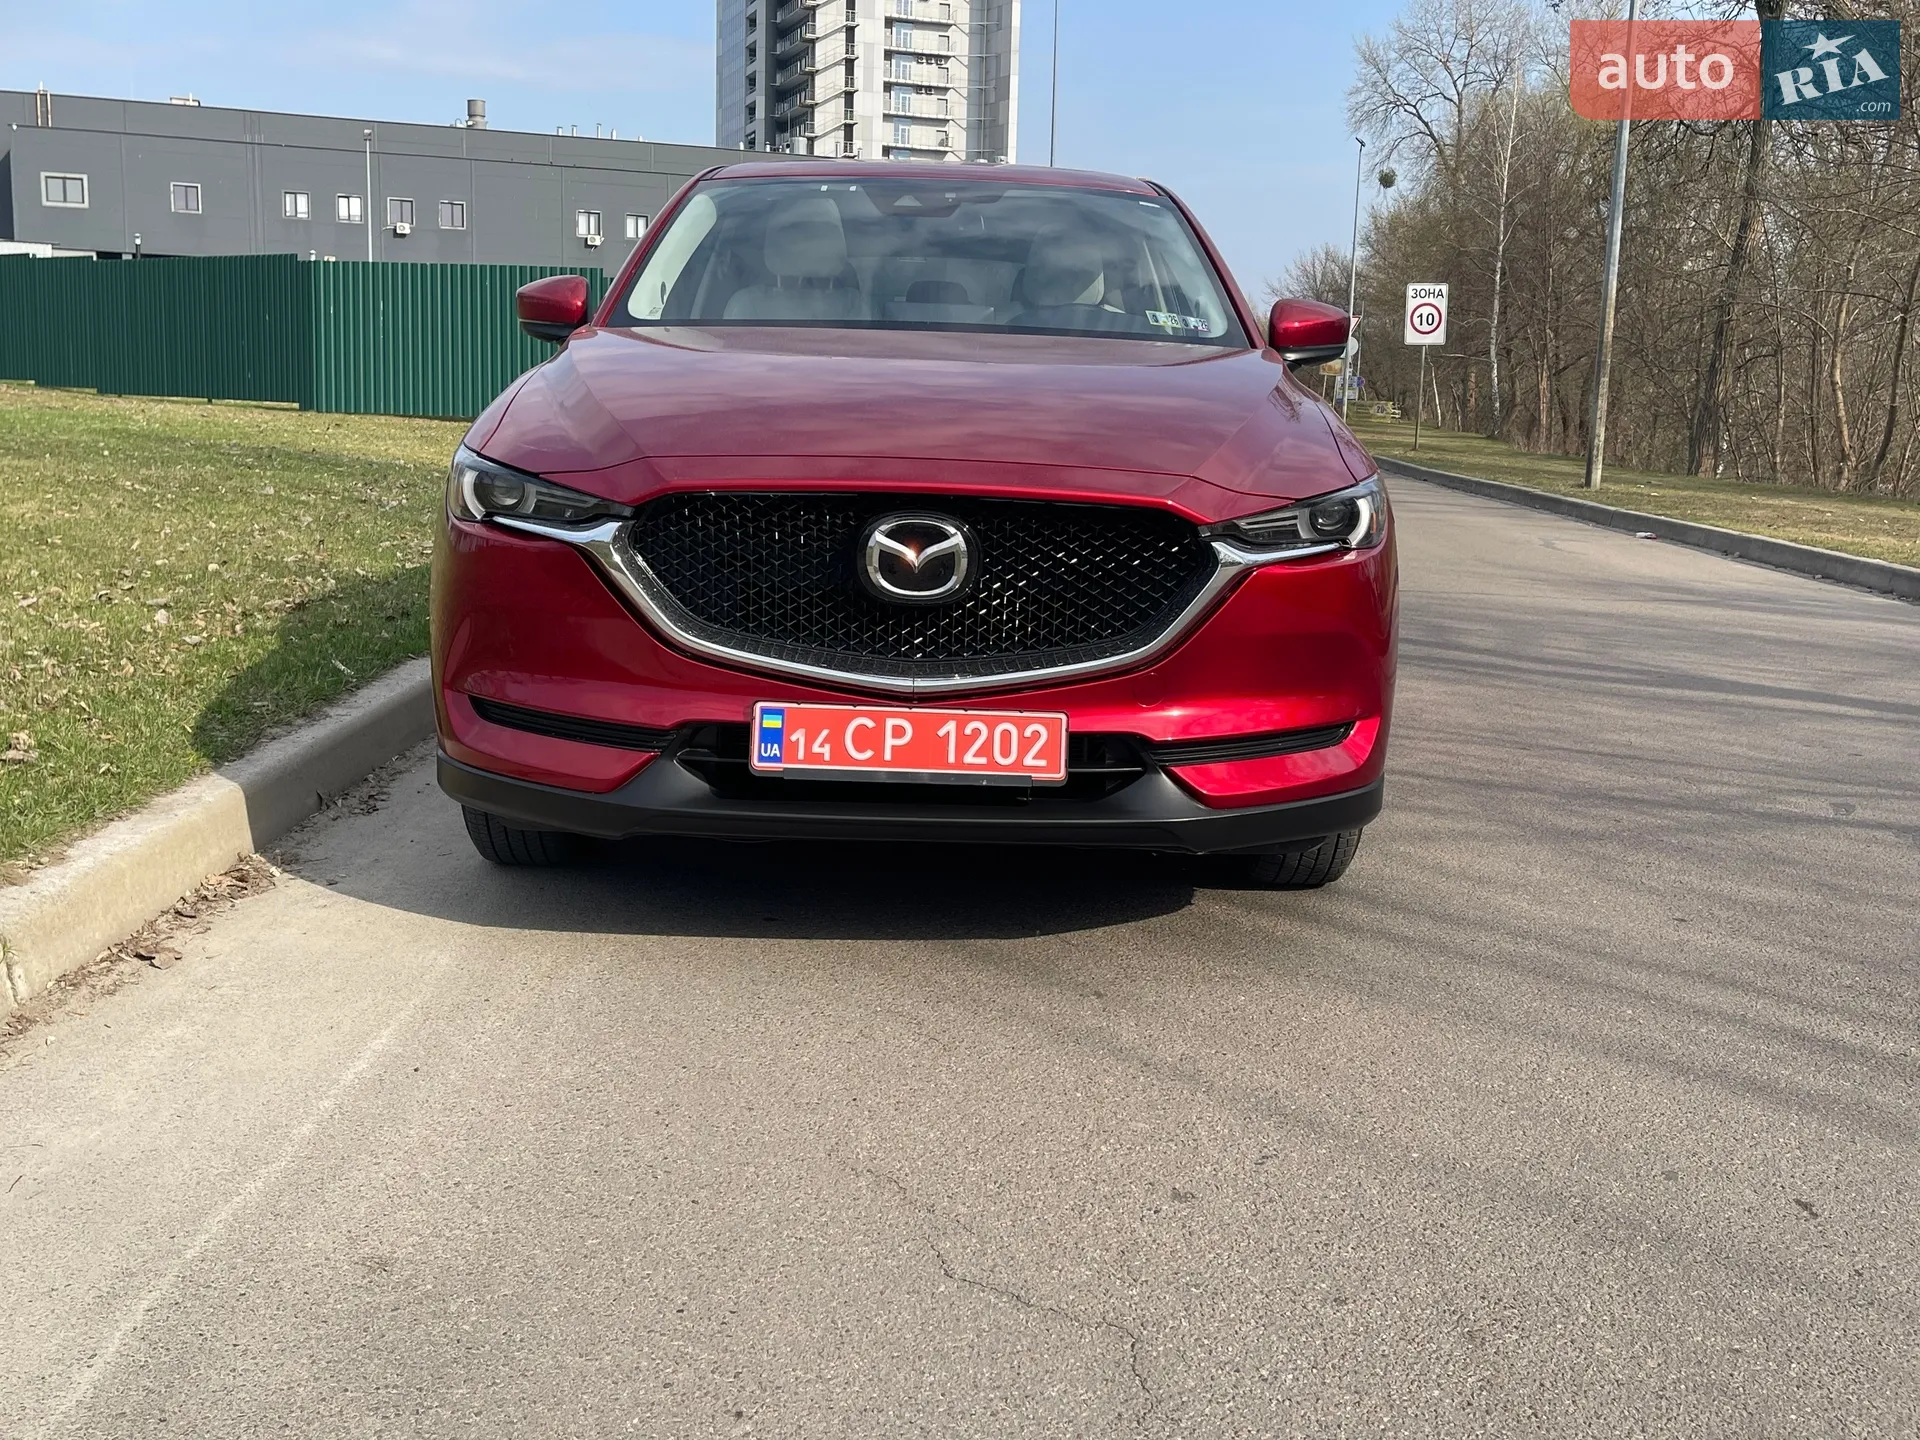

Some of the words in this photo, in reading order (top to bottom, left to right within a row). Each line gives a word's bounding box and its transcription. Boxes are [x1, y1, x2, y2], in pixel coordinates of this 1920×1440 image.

[1411, 288, 1445, 299] ЗОНА
[1416, 313, 1435, 326] 10
[789, 727, 831, 761] 14
[844, 716, 914, 761] CP
[936, 719, 1049, 767] 1202
[760, 743, 781, 757] UA
